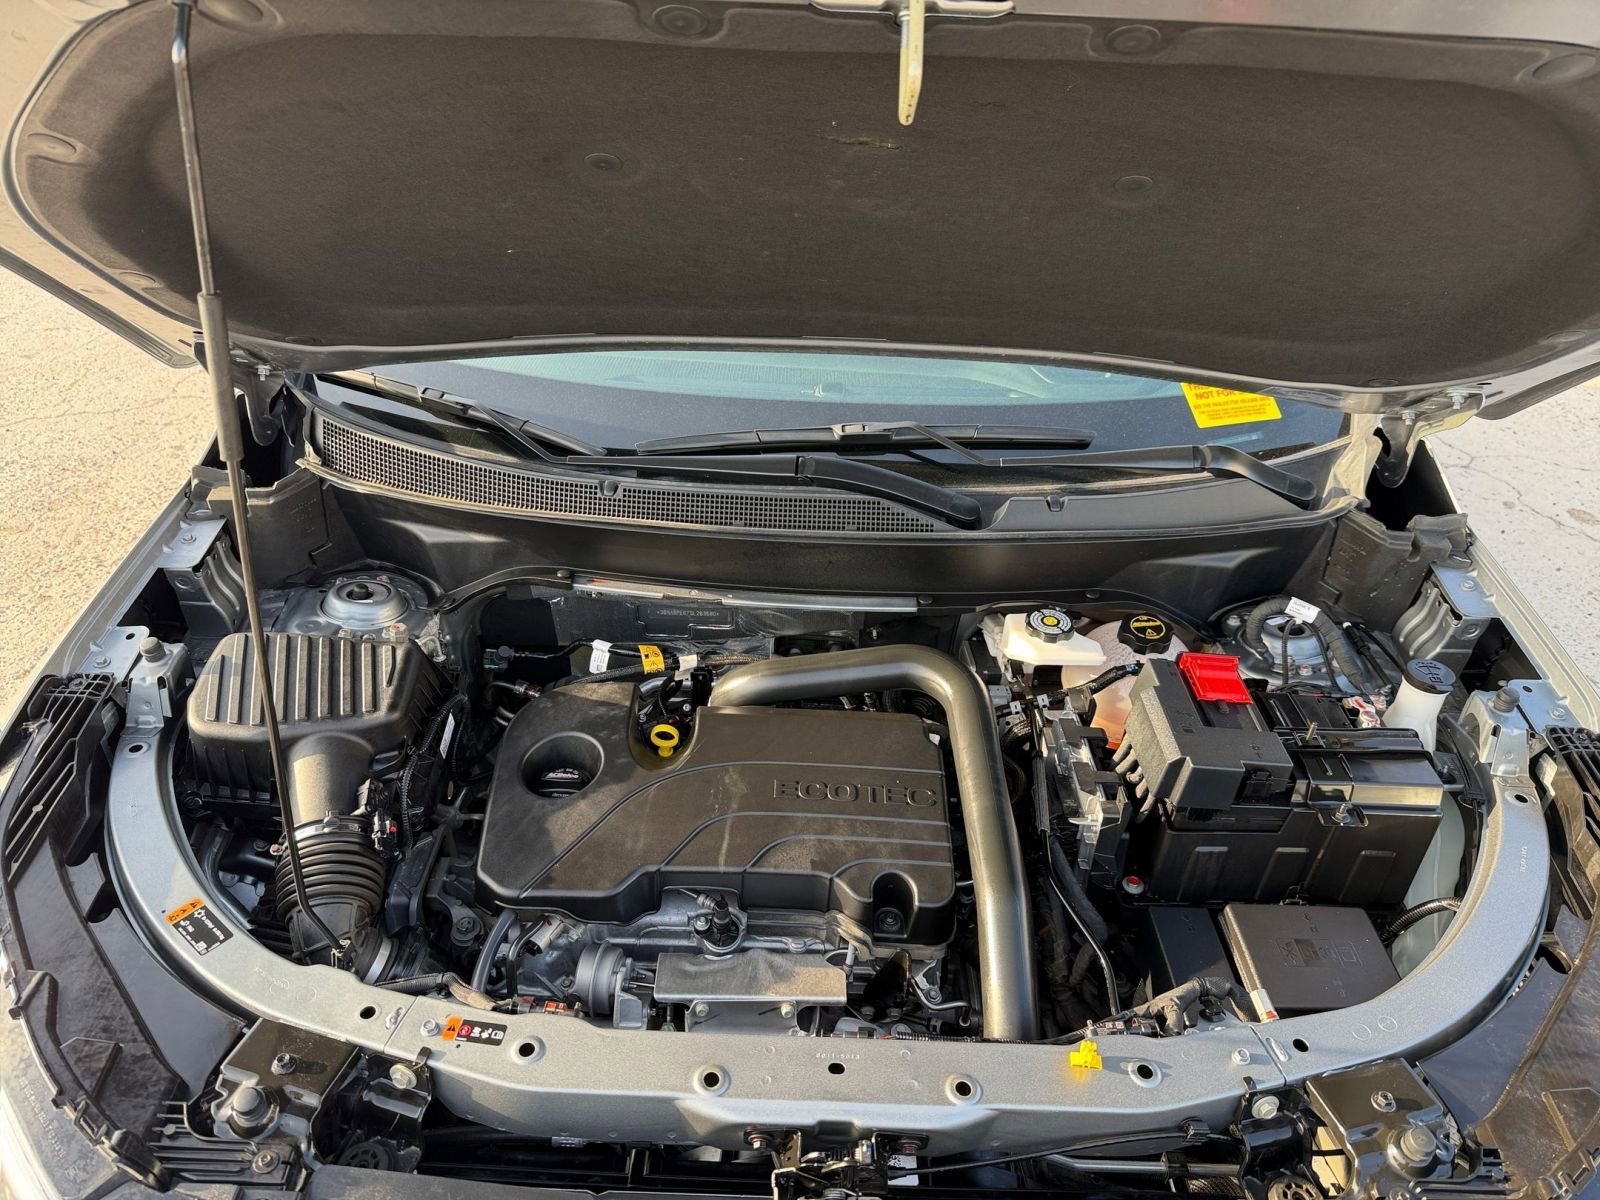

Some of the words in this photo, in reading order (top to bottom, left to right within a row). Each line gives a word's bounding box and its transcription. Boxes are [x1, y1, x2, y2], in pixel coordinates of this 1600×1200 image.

[1194, 390, 1214, 400] NOT
[1217, 388, 1236, 398] FOR
[773, 779, 937, 807] ECOTEC
